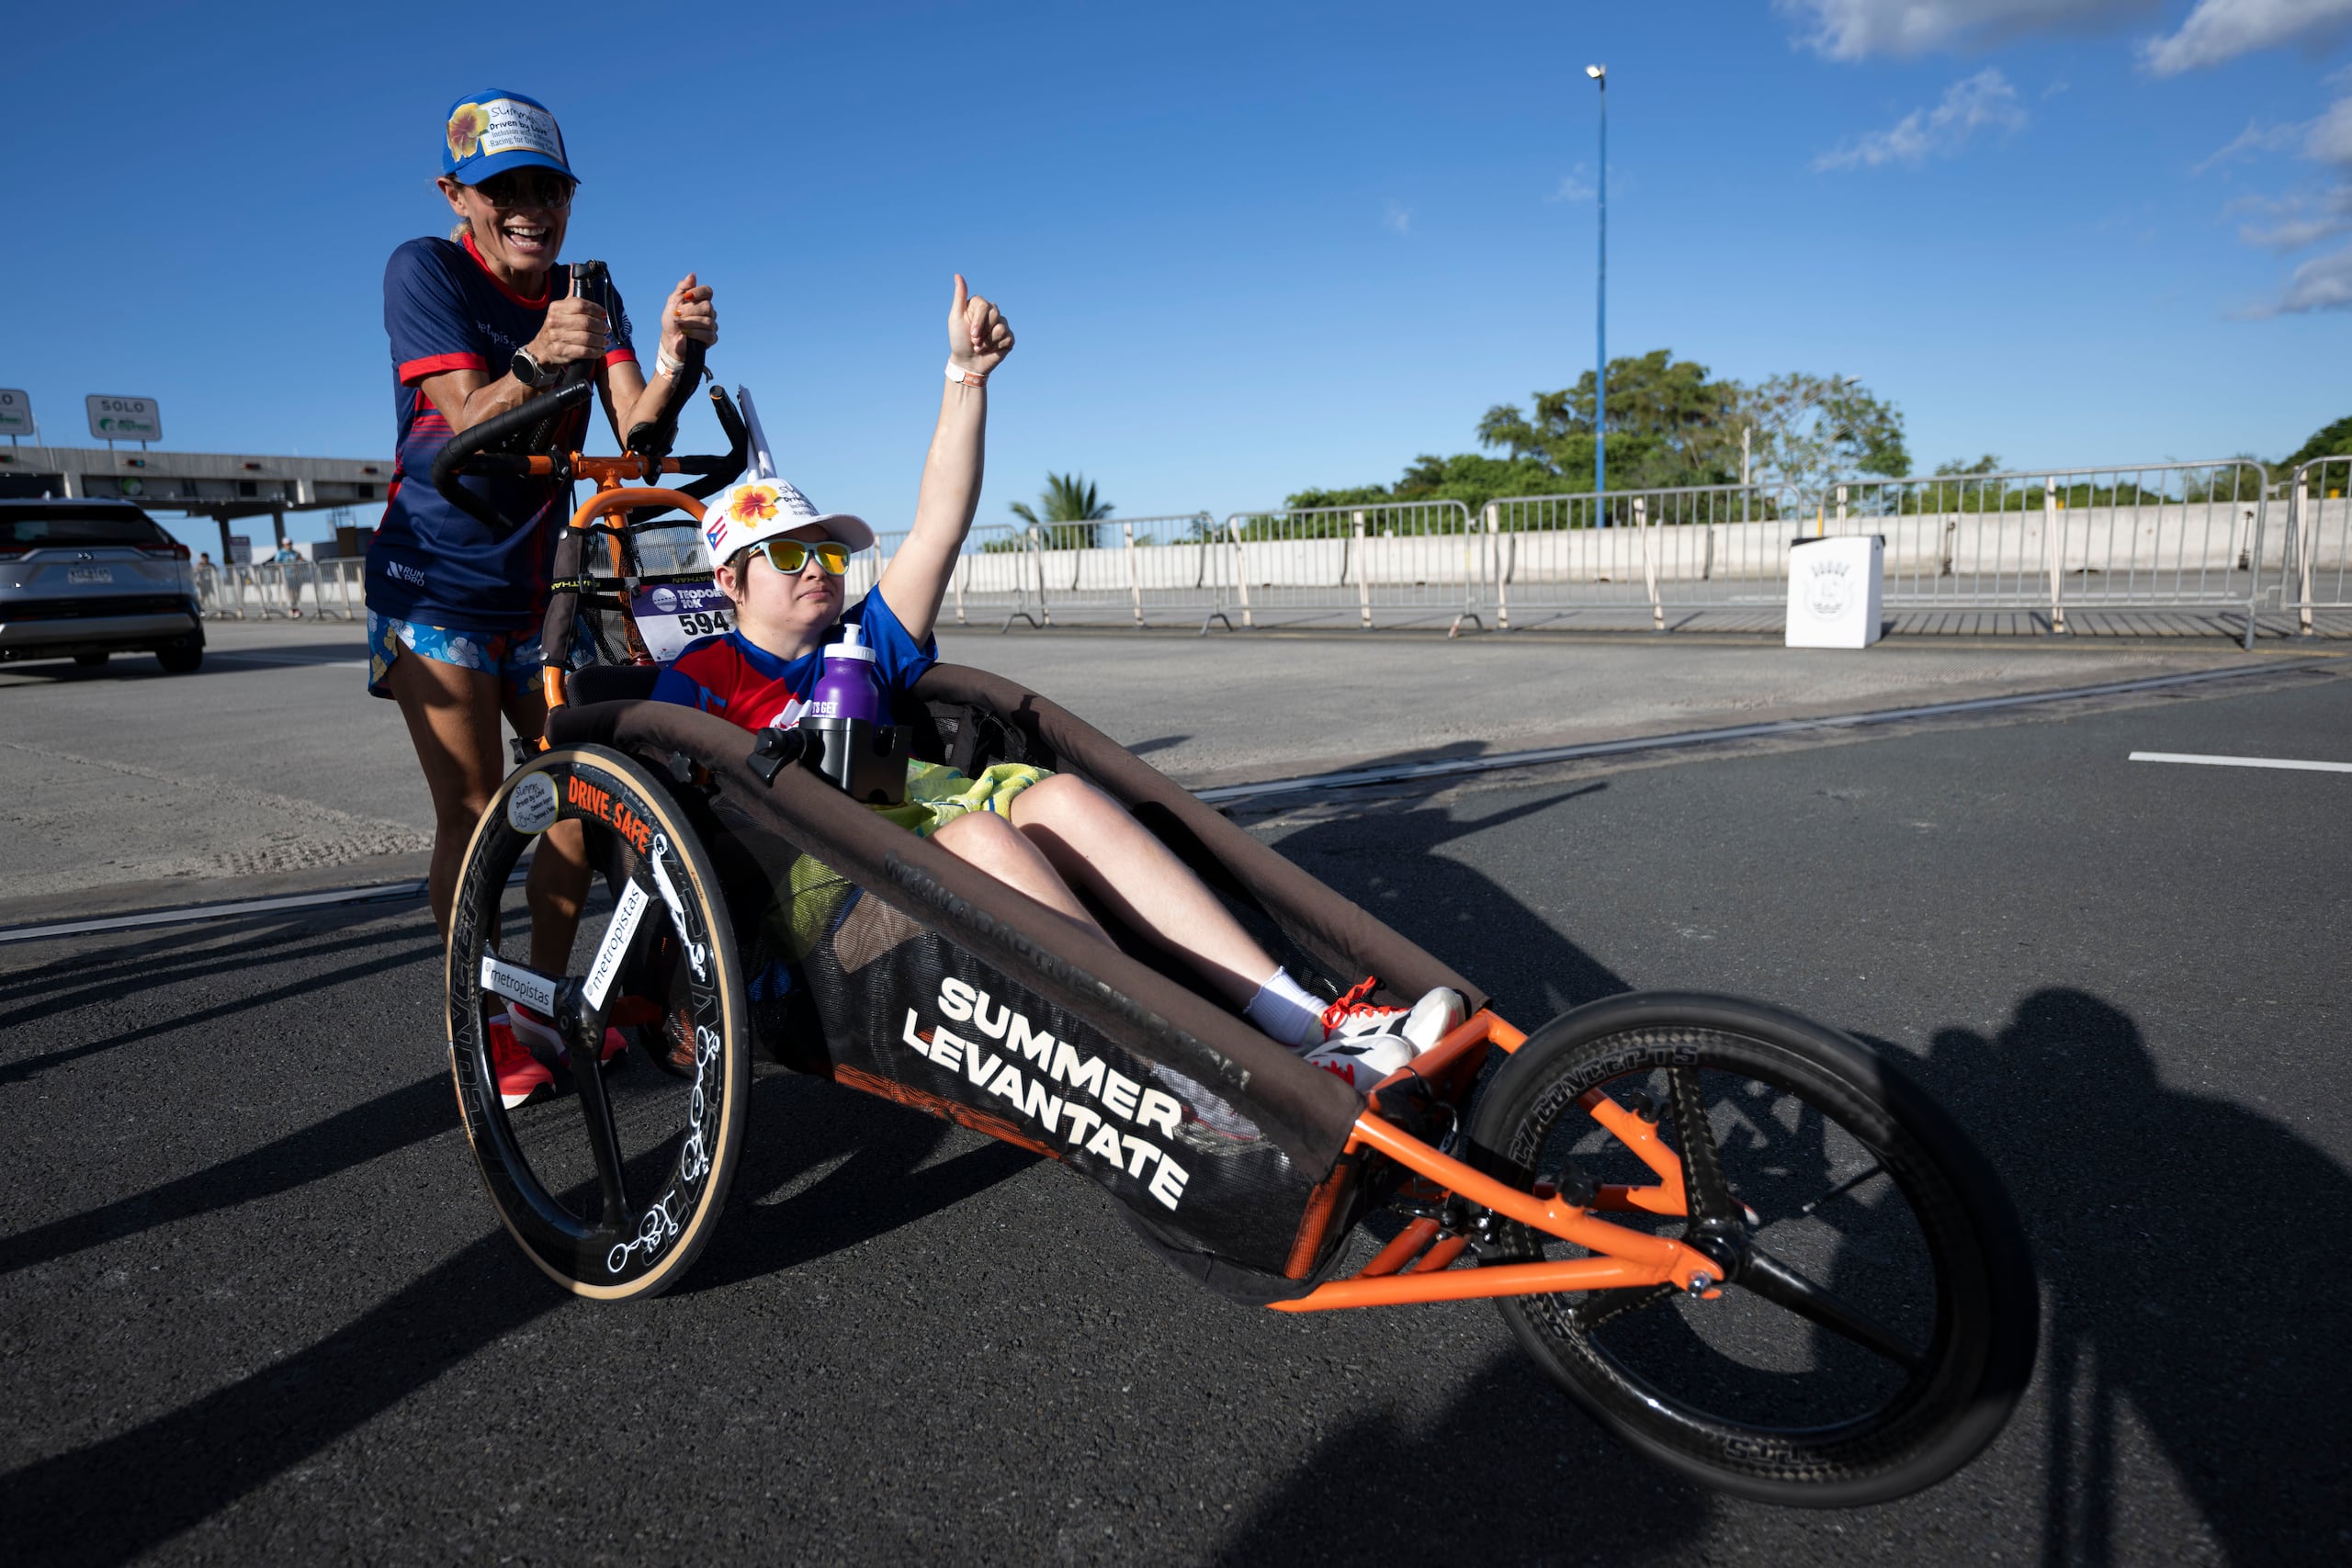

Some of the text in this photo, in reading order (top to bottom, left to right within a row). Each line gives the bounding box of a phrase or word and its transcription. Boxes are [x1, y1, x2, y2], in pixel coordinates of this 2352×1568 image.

[489, 120, 548, 136] Driven by Love
[101, 400, 145, 413] SOLO
[403, 566, 425, 580] RUN
[404, 574, 425, 587] PRO
[677, 588, 725, 599] TEODOR
[681, 599, 703, 609] 10K
[678, 611, 729, 636] 594
[821, 701, 838, 714] GET
[568, 775, 651, 854] DRIVE SAFE
[592, 887, 640, 991] metropistas
[491, 967, 550, 1006] metropistas
[937, 976, 1183, 1141] SUMMER
[1531, 1043, 1699, 1124] CONCEPTS
[901, 1007, 1190, 1213] LEVANTATE
